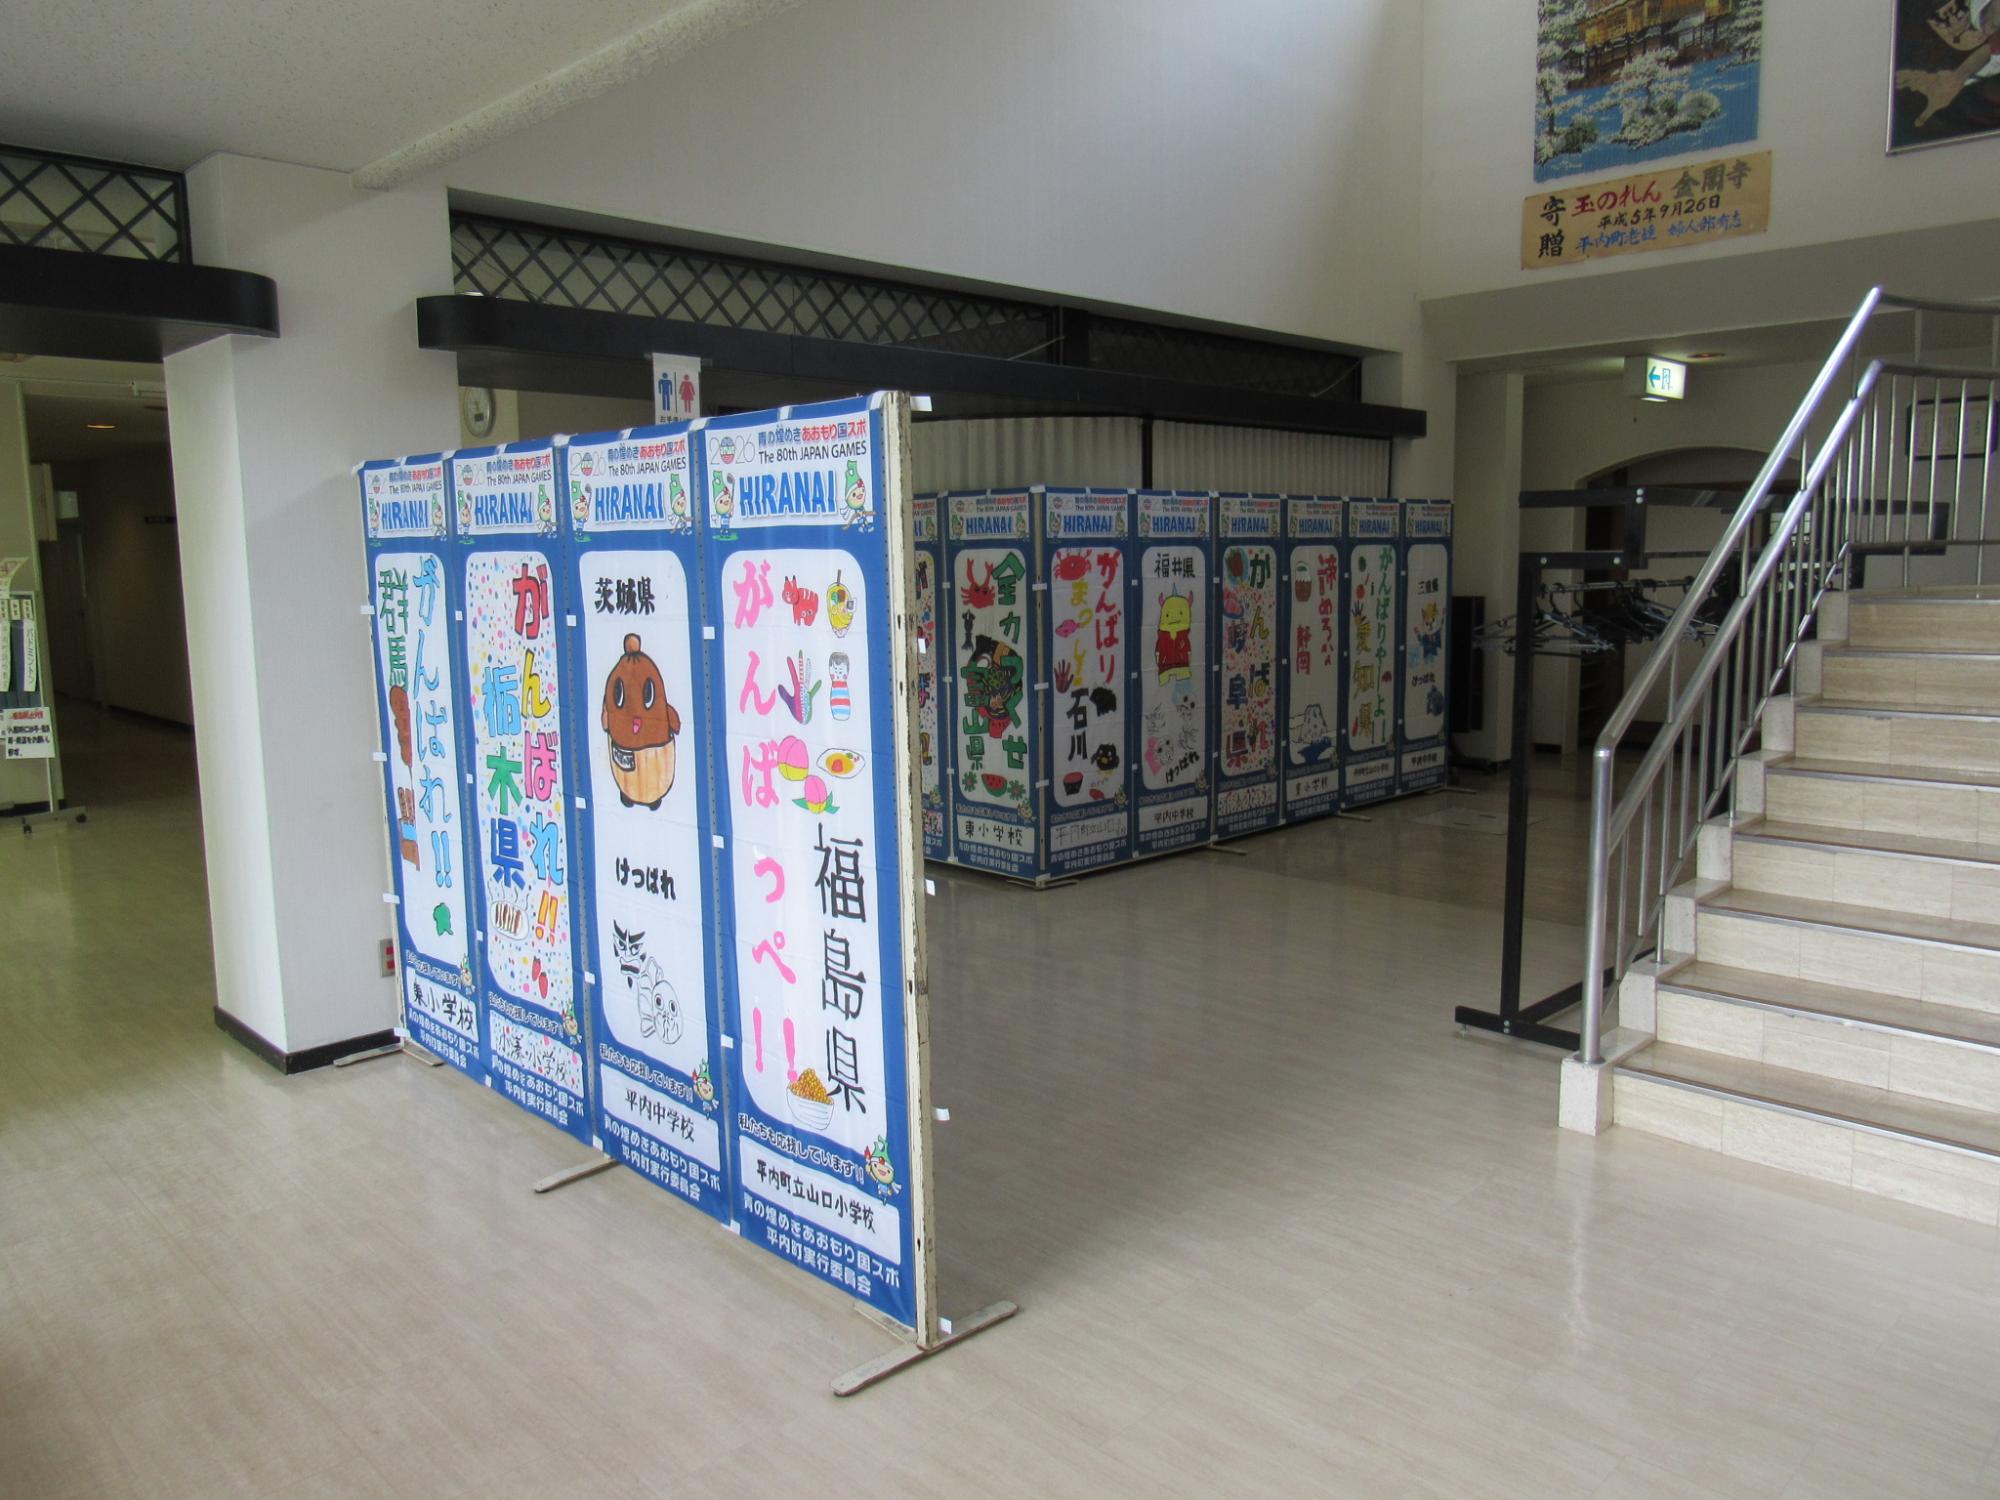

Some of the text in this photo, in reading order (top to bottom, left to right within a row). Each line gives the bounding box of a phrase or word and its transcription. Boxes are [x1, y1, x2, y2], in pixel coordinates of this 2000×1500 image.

[1571, 180, 1663, 217] 玉のれん
[1597, 194, 1721, 230] 平成5年9月26日
[1538, 195, 1566, 258] 寄贈
[609, 457, 686, 477] The 80th JAPAN GAMES
[759, 440, 867, 464] The 80th JAPAN GAMES
[487, 469, 552, 486] The 80th JAPAN GAMES
[739, 470, 836, 516] HIRANAI
[382, 500, 428, 529] HIRANAI
[474, 492, 533, 526] HIRANAI
[595, 483, 664, 521] HIRANAI
[966, 516, 1012, 534] HIRANAI
[1063, 515, 1112, 532] HIRANAI
[1153, 516, 1195, 532] HIRANAI
[1154, 553, 1195, 578] 福井県
[594, 576, 656, 616] 茨城県
[1067, 688, 1089, 761] 石川
[965, 820, 1023, 847] 東小学校
[814, 822, 867, 1114] 福島県
[413, 978, 475, 1034] 東小学校
[625, 1088, 695, 1142] 平内中学校
[756, 1159, 876, 1233] 平内町立山口小学校
[767, 1226, 871, 1296] 平内町実行委員会
